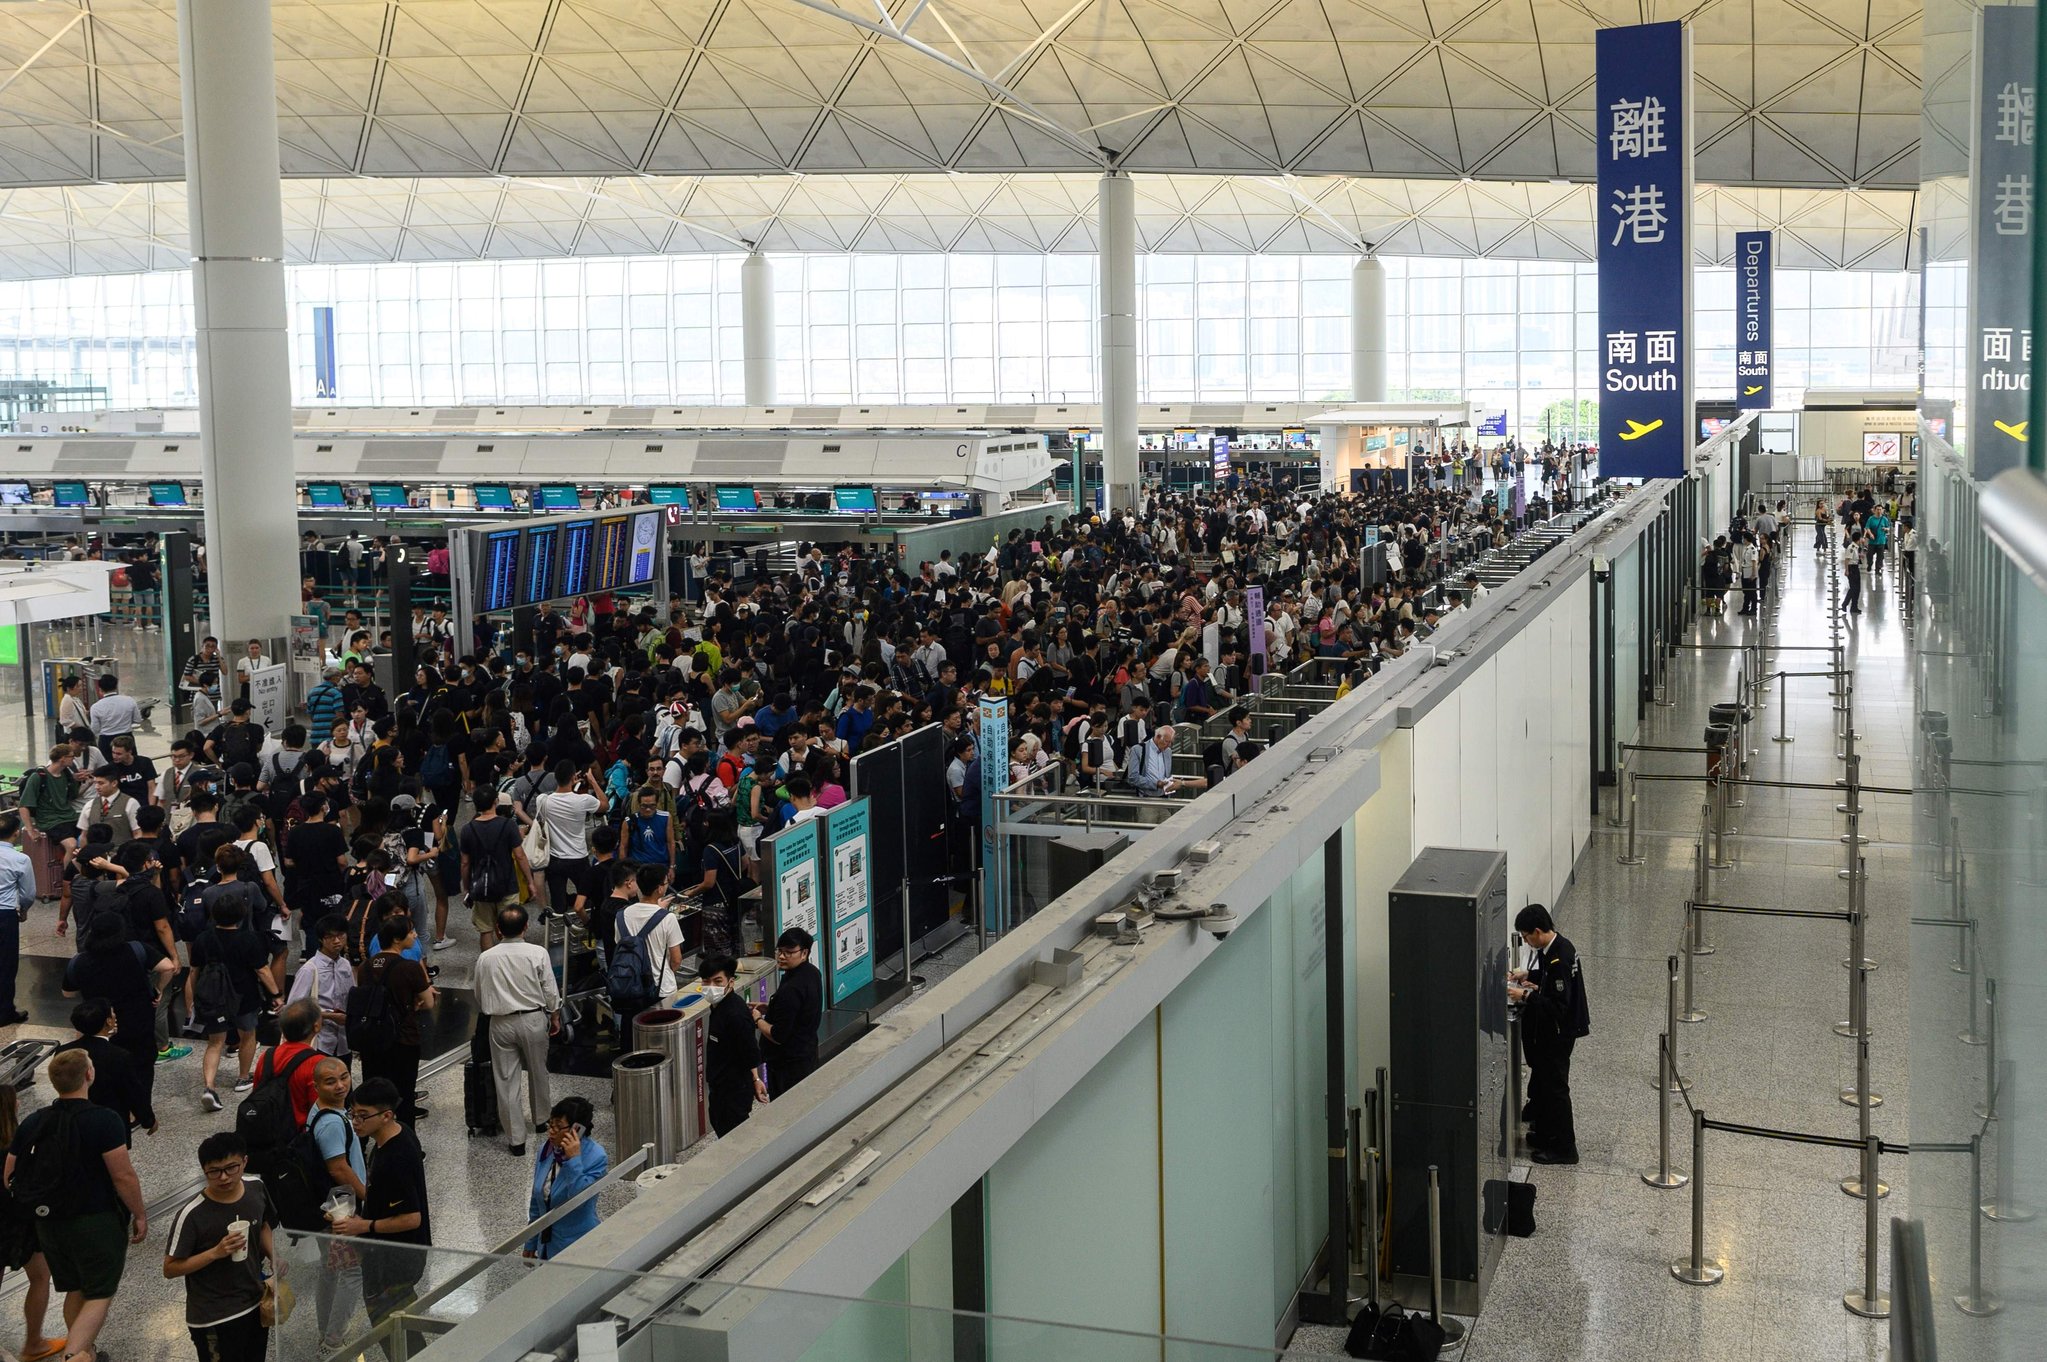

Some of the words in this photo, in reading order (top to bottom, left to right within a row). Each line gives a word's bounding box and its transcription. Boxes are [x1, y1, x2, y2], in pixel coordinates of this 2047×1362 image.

[1609, 96, 1669, 247] 離港
[1743, 240, 1763, 342] Departures
[1606, 330, 1677, 365] 南面
[1738, 350, 1768, 365] 南面
[1738, 365, 1768, 376] South
[317, 378, 327, 396] A
[1606, 368, 1677, 392] South
[329, 386, 336, 396] A
[956, 444, 968, 458] C
[262, 699, 274, 709] 出口
